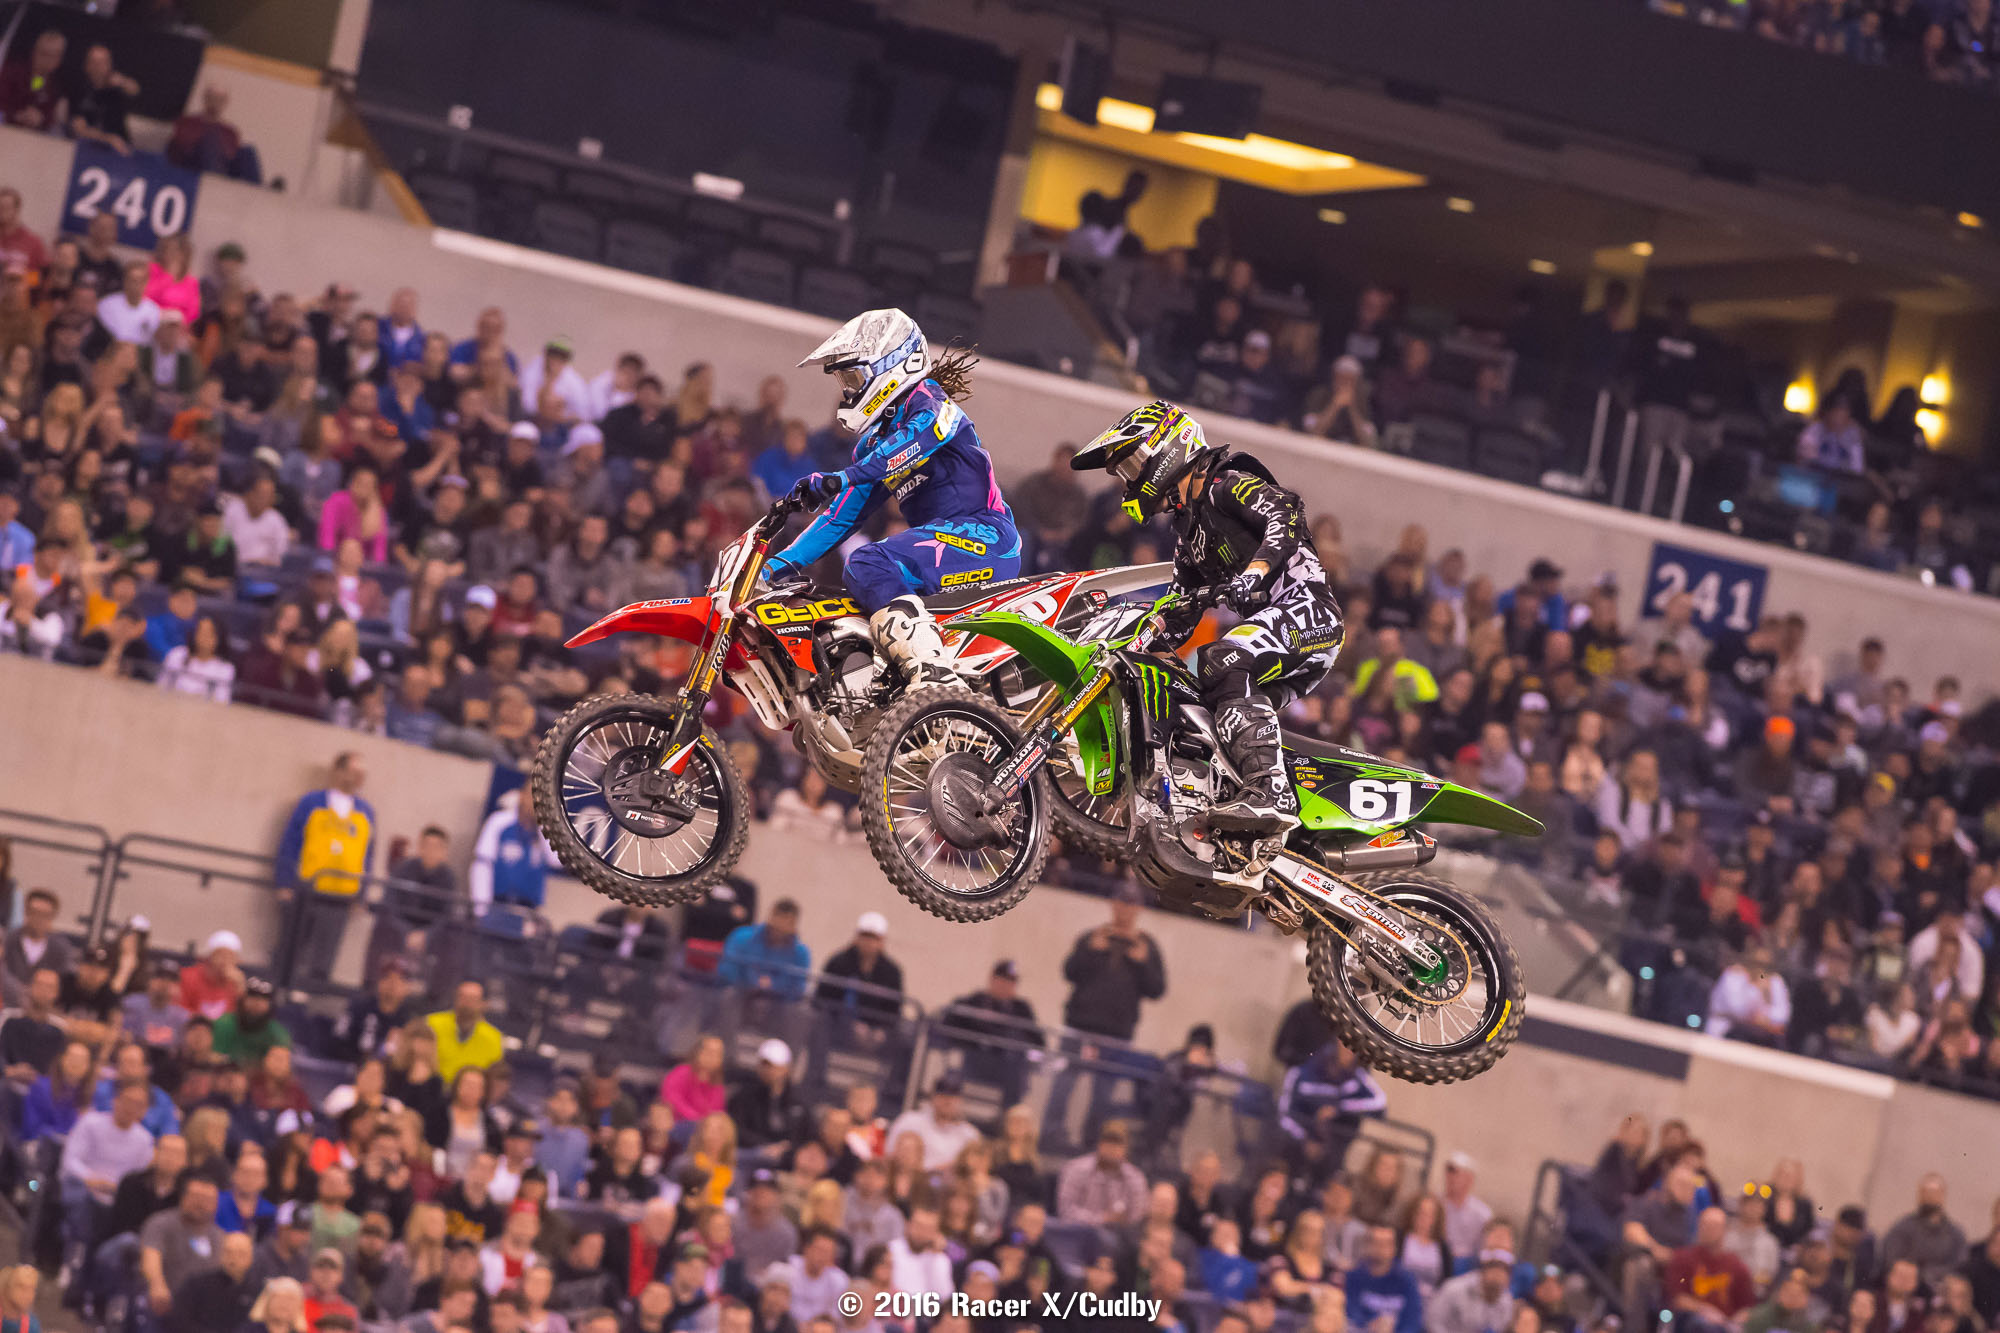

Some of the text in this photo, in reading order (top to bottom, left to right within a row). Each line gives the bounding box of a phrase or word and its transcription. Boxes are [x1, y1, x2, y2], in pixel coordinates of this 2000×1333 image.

[72, 167, 187, 238] 240
[864, 379, 899, 416] GEICO
[1181, 428, 1192, 441] BELL
[888, 443, 921, 470] AMSOIL
[1151, 447, 1180, 484] MONSTER
[896, 473, 930, 500] ONDA
[935, 531, 987, 556] GEICO
[941, 568, 994, 587] GEICO
[980, 578, 1030, 590] HONDA
[644, 598, 692, 608] AMSOIL
[1653, 562, 1753, 631] 241
[756, 597, 861, 625] GEICO
[776, 625, 811, 635] HONDA
[1300, 626, 1334, 640] MONSTER
[1223, 650, 1241, 667] FOX
[1061, 668, 1103, 717] PRO CIRCUIT
[1082, 678, 1107, 707] SHOWA
[1257, 723, 1278, 739] FOX
[992, 734, 1037, 786] DUNLOP
[1015, 746, 1042, 777] BRAKING
[1350, 779, 1412, 824] 61
[1301, 878, 1331, 897] BRAKING
[1307, 872, 1321, 883] RK
